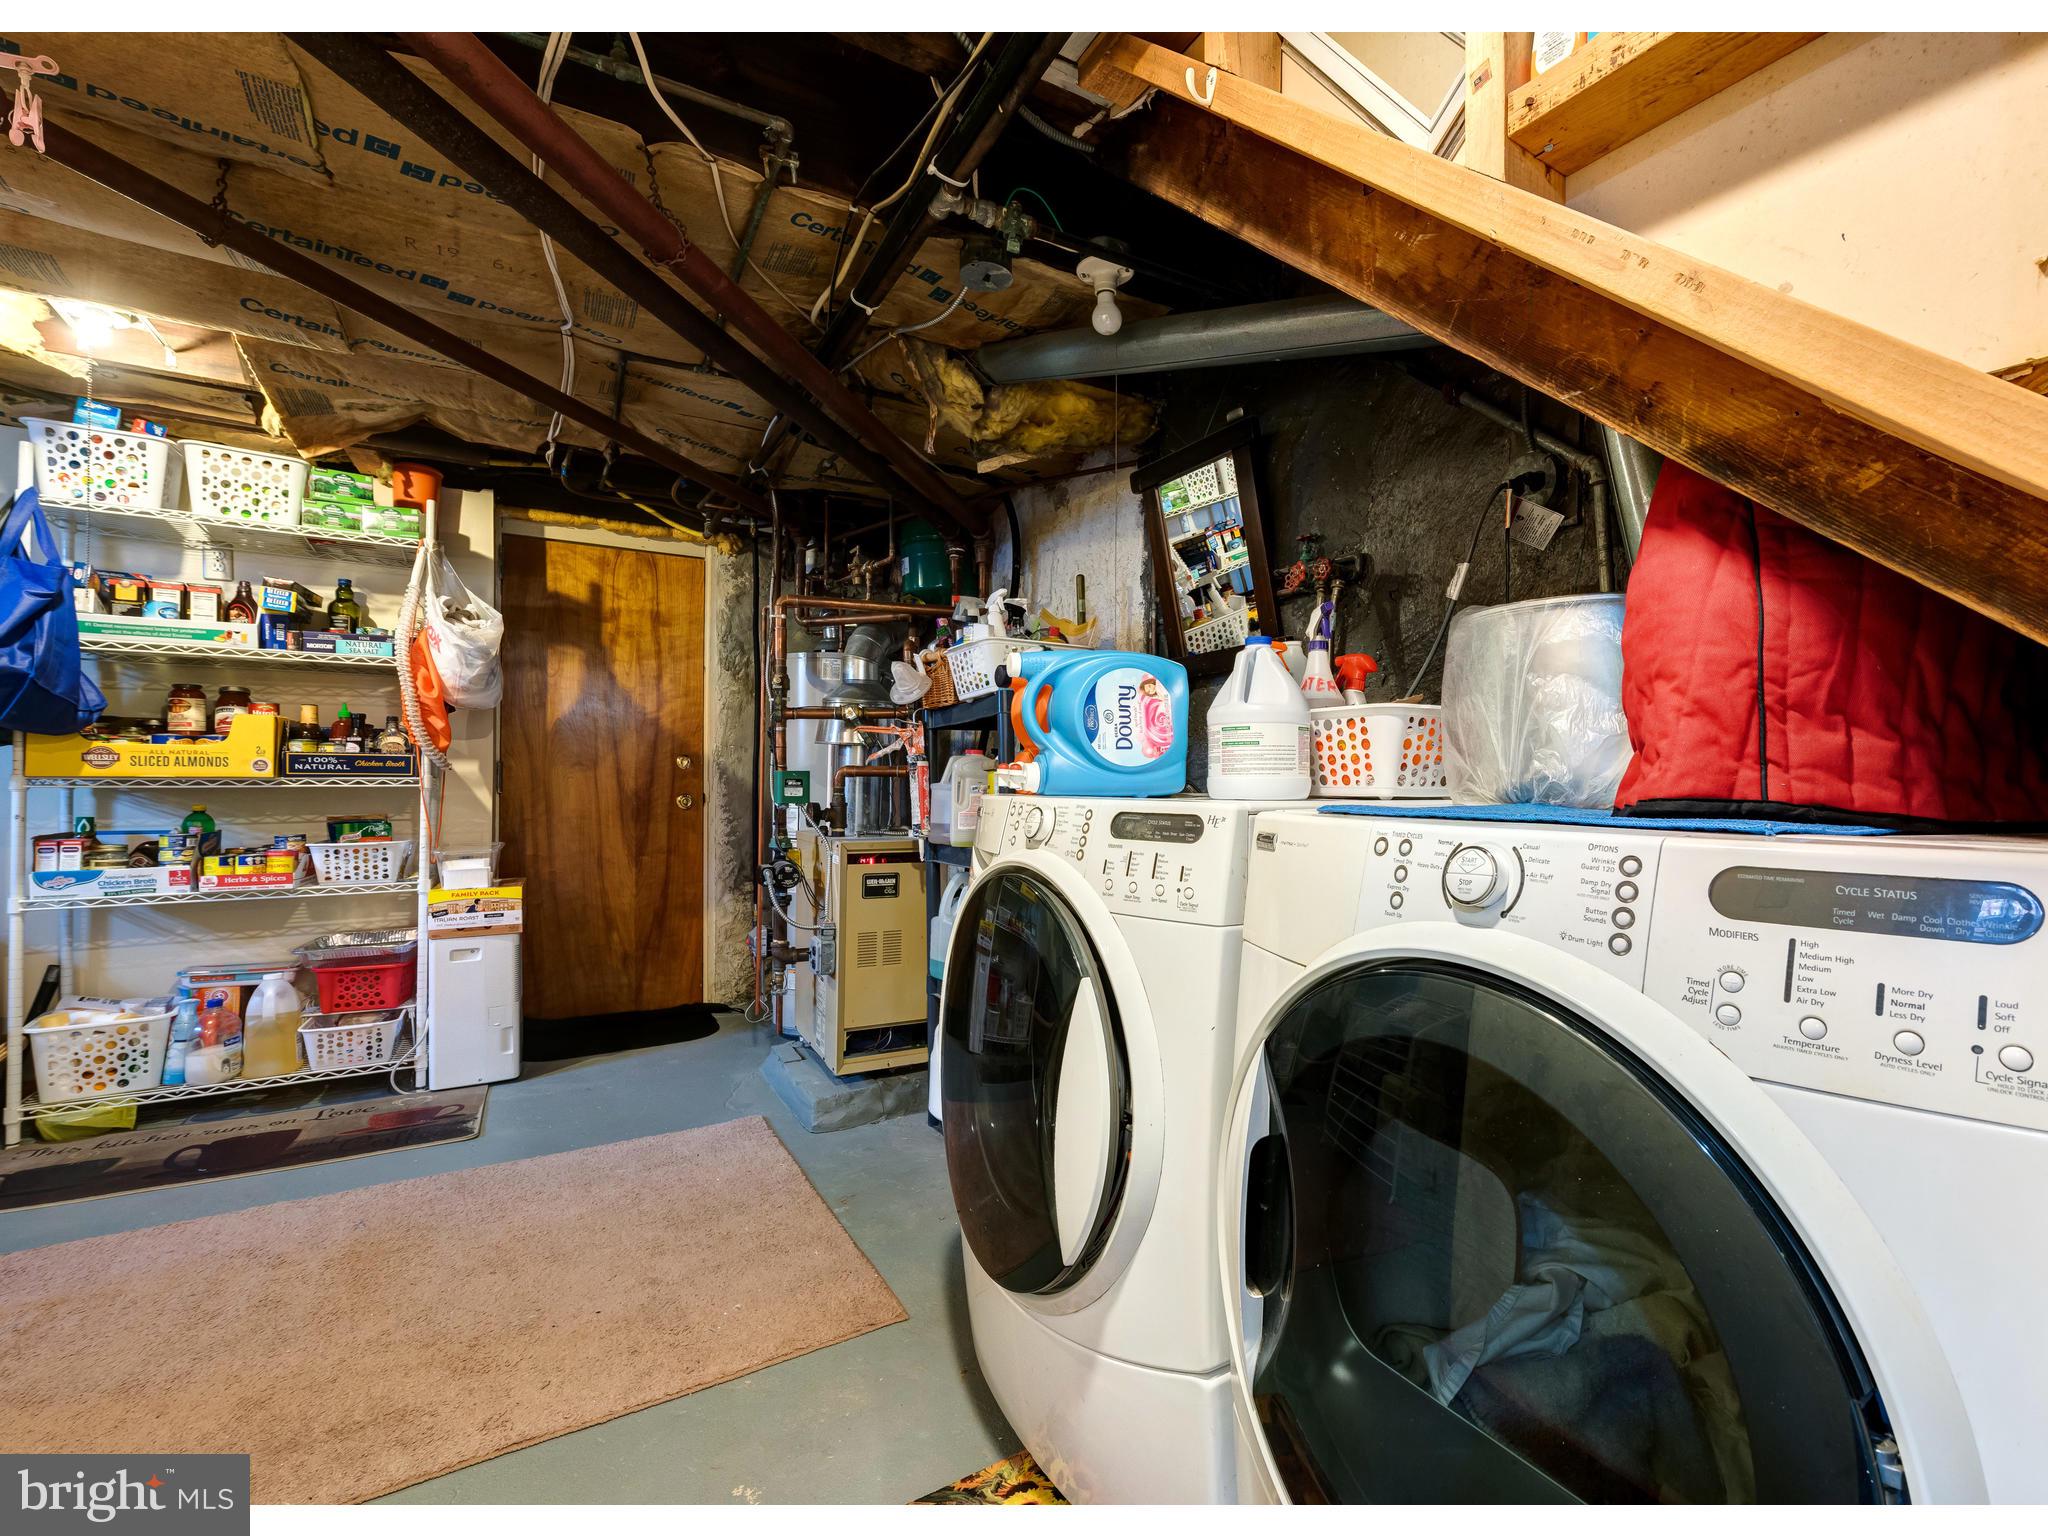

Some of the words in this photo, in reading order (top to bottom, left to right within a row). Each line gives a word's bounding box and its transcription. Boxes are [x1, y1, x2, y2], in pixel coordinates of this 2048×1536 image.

[478, 300, 624, 344] CertinTeed
[306, 642, 335, 650] MORTON
[1300, 676, 1337, 692] ATER
[1115, 684, 1137, 750] Downy
[83, 752, 119, 761] WELLSLEY
[130, 756, 170, 767] SLICED
[174, 756, 230, 768] ALMONDS
[307, 756, 338, 764] 100%
[354, 760, 384, 768] Chicken
[385, 760, 405, 768] Broth
[294, 763, 351, 771] NATURAL
[1587, 842, 1619, 853] OPTIONS
[1528, 857, 1551, 865] Delicate
[1591, 857, 1616, 865] Wrinkle
[1581, 863, 1600, 871] Guard
[98, 879, 132, 887] Chicken
[133, 878, 157, 886] Broth
[224, 875, 249, 883] Herbs
[260, 875, 286, 883] Spices
[1580, 878, 1598, 887] Damp
[1600, 880, 1612, 888] Dry
[1590, 887, 1611, 895] Signal
[1835, 885, 1870, 897] CYCLE
[1873, 888, 1917, 901] STATUS
[1585, 907, 1608, 916] Button
[1583, 915, 1607, 924] Sounds
[1832, 907, 1856, 918] Timed
[1868, 911, 1885, 920] Wet
[1891, 913, 1917, 924] Damp
[1923, 915, 1943, 925] Cool
[1946, 917, 1981, 928] Clothes
[1983, 920, 2018, 930] Wrinkle
[1832, 916, 1854, 926] Cycle
[1919, 924, 1945, 934] Down
[1955, 927, 1971, 937] Dry
[1985, 930, 2014, 940] Guard
[1708, 927, 1759, 942] MODIFIERS
[1568, 935, 1585, 943] Drum
[1586, 938, 1603, 947] Light
[1800, 940, 1820, 949] High
[1799, 952, 1832, 962] Medium
[1835, 955, 1855, 965] High
[1798, 963, 1832, 973] Medium
[1686, 976, 1710, 988] Timed
[1797, 975, 1814, 983] Low
[1688, 986, 1709, 997] Cycle
[1796, 985, 1818, 995] Extra
[1819, 988, 1837, 997] Low
[1891, 986, 1915, 997] More
[1918, 989, 1934, 1000] Dry
[1681, 994, 1708, 1006] Adjust
[1796, 997, 1808, 1005] Air
[1810, 998, 1825, 1008] Dry
[1890, 999, 1926, 1011] Normal
[1995, 1000, 2019, 1010] Loud
[1889, 1010, 1908, 1020] Less
[1910, 1013, 1926, 1023] Dry
[1994, 1012, 2016, 1022] Soft
[1993, 1025, 2011, 1034] Off
[1783, 1035, 1841, 1053] Temperature
[1874, 1050, 1913, 1066] Dryness
[1916, 1058, 1943, 1072] Level
[1985, 1070, 2014, 1084] Cycle
[2017, 1075, 2048, 1090] Signa
[2027, 1087, 2045, 1096] LOCK
[11, 1142, 83, 1161] This
[92, 1131, 193, 1153] kitchen
[198, 1122, 260, 1137] runs
[268, 1115, 298, 1128] on
[309, 1104, 377, 1123] Love
